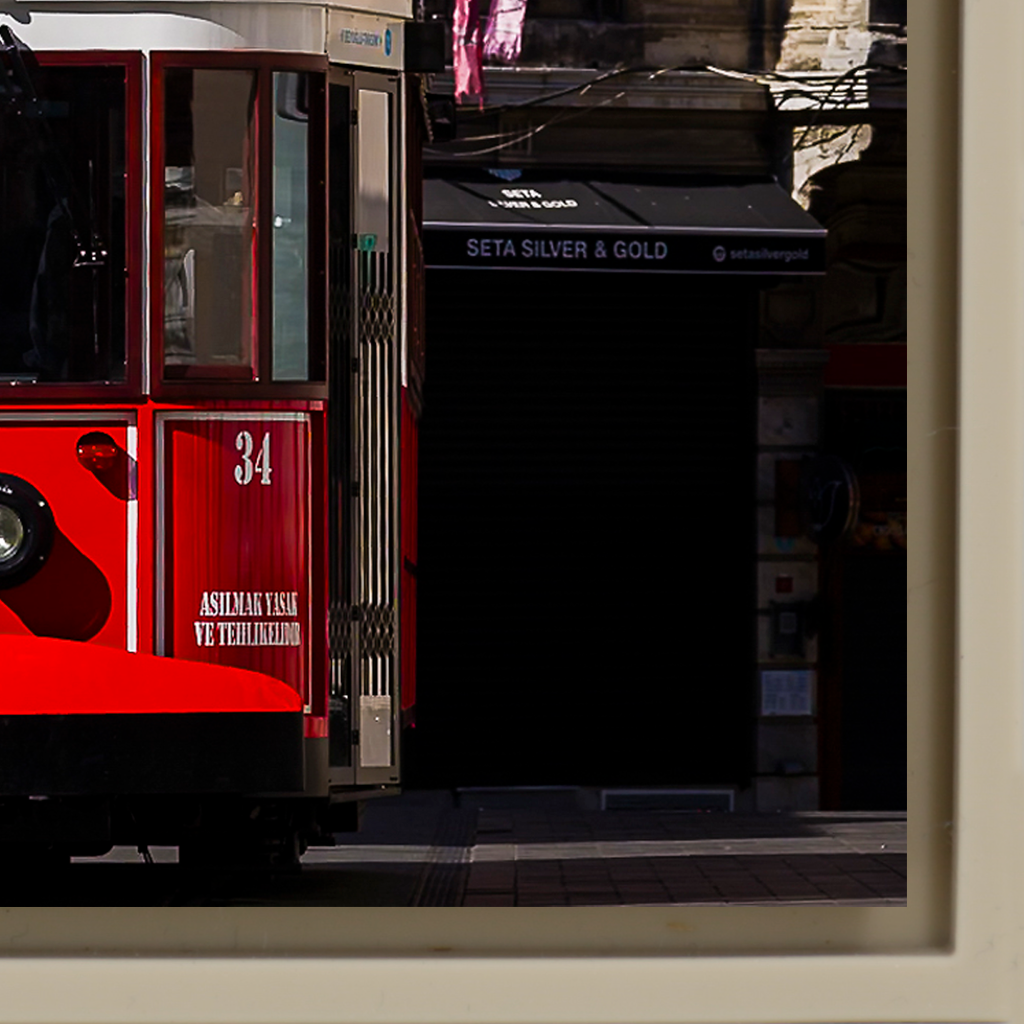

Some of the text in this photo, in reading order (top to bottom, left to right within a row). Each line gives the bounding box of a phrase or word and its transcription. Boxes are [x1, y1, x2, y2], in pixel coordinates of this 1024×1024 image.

[466, 238, 668, 260] SETA SILVER & GOLD
[234, 430, 273, 486] 34
[199, 590, 299, 617] ASILMAK YASAK
[193, 621, 215, 647] VE
